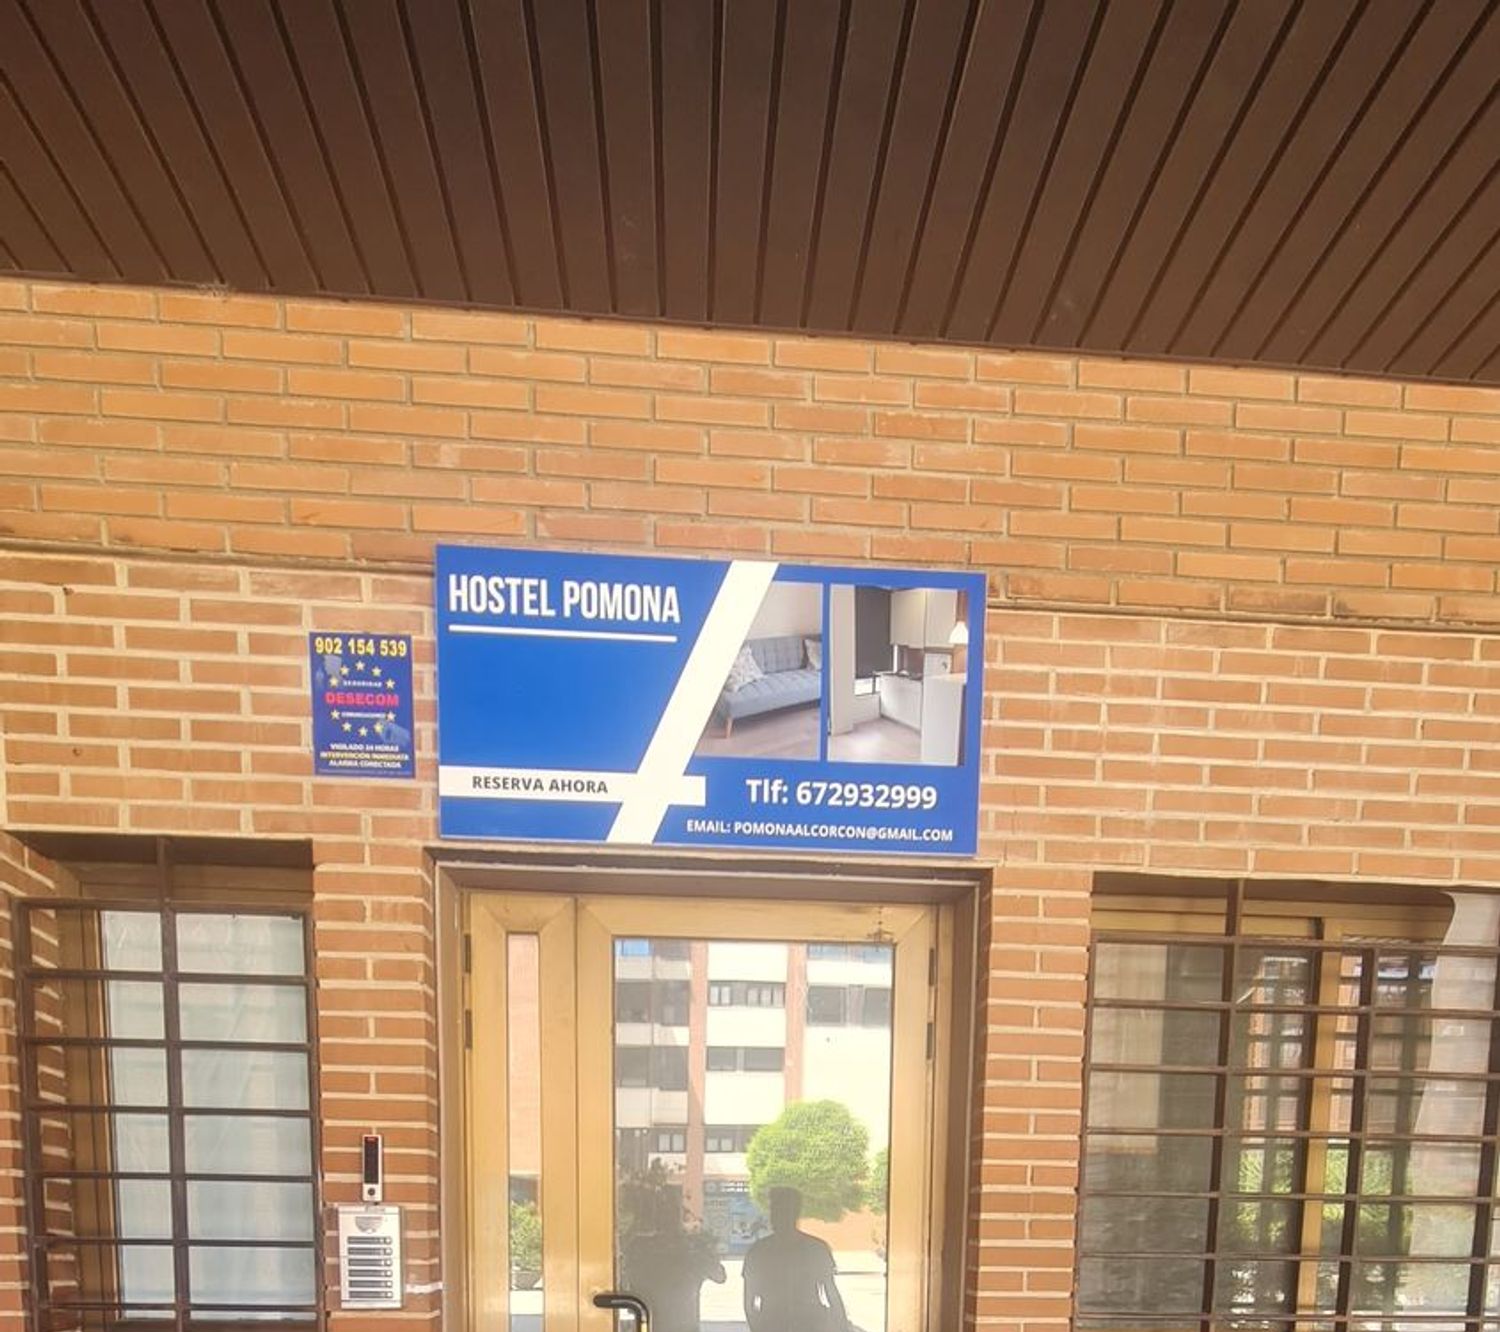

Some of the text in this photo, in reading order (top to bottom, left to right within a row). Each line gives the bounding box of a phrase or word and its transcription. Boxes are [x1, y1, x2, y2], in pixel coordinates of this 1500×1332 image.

[449, 573, 681, 624] HOSTEL POMONA
[315, 637, 407, 657] 902 154 539
[472, 775, 608, 794] RESERVA AHORA
[746, 779, 937, 810] Tlf: 672932999
[686, 819, 953, 841] EMAIL: POMONAALCORCON@GMAIL.COM
